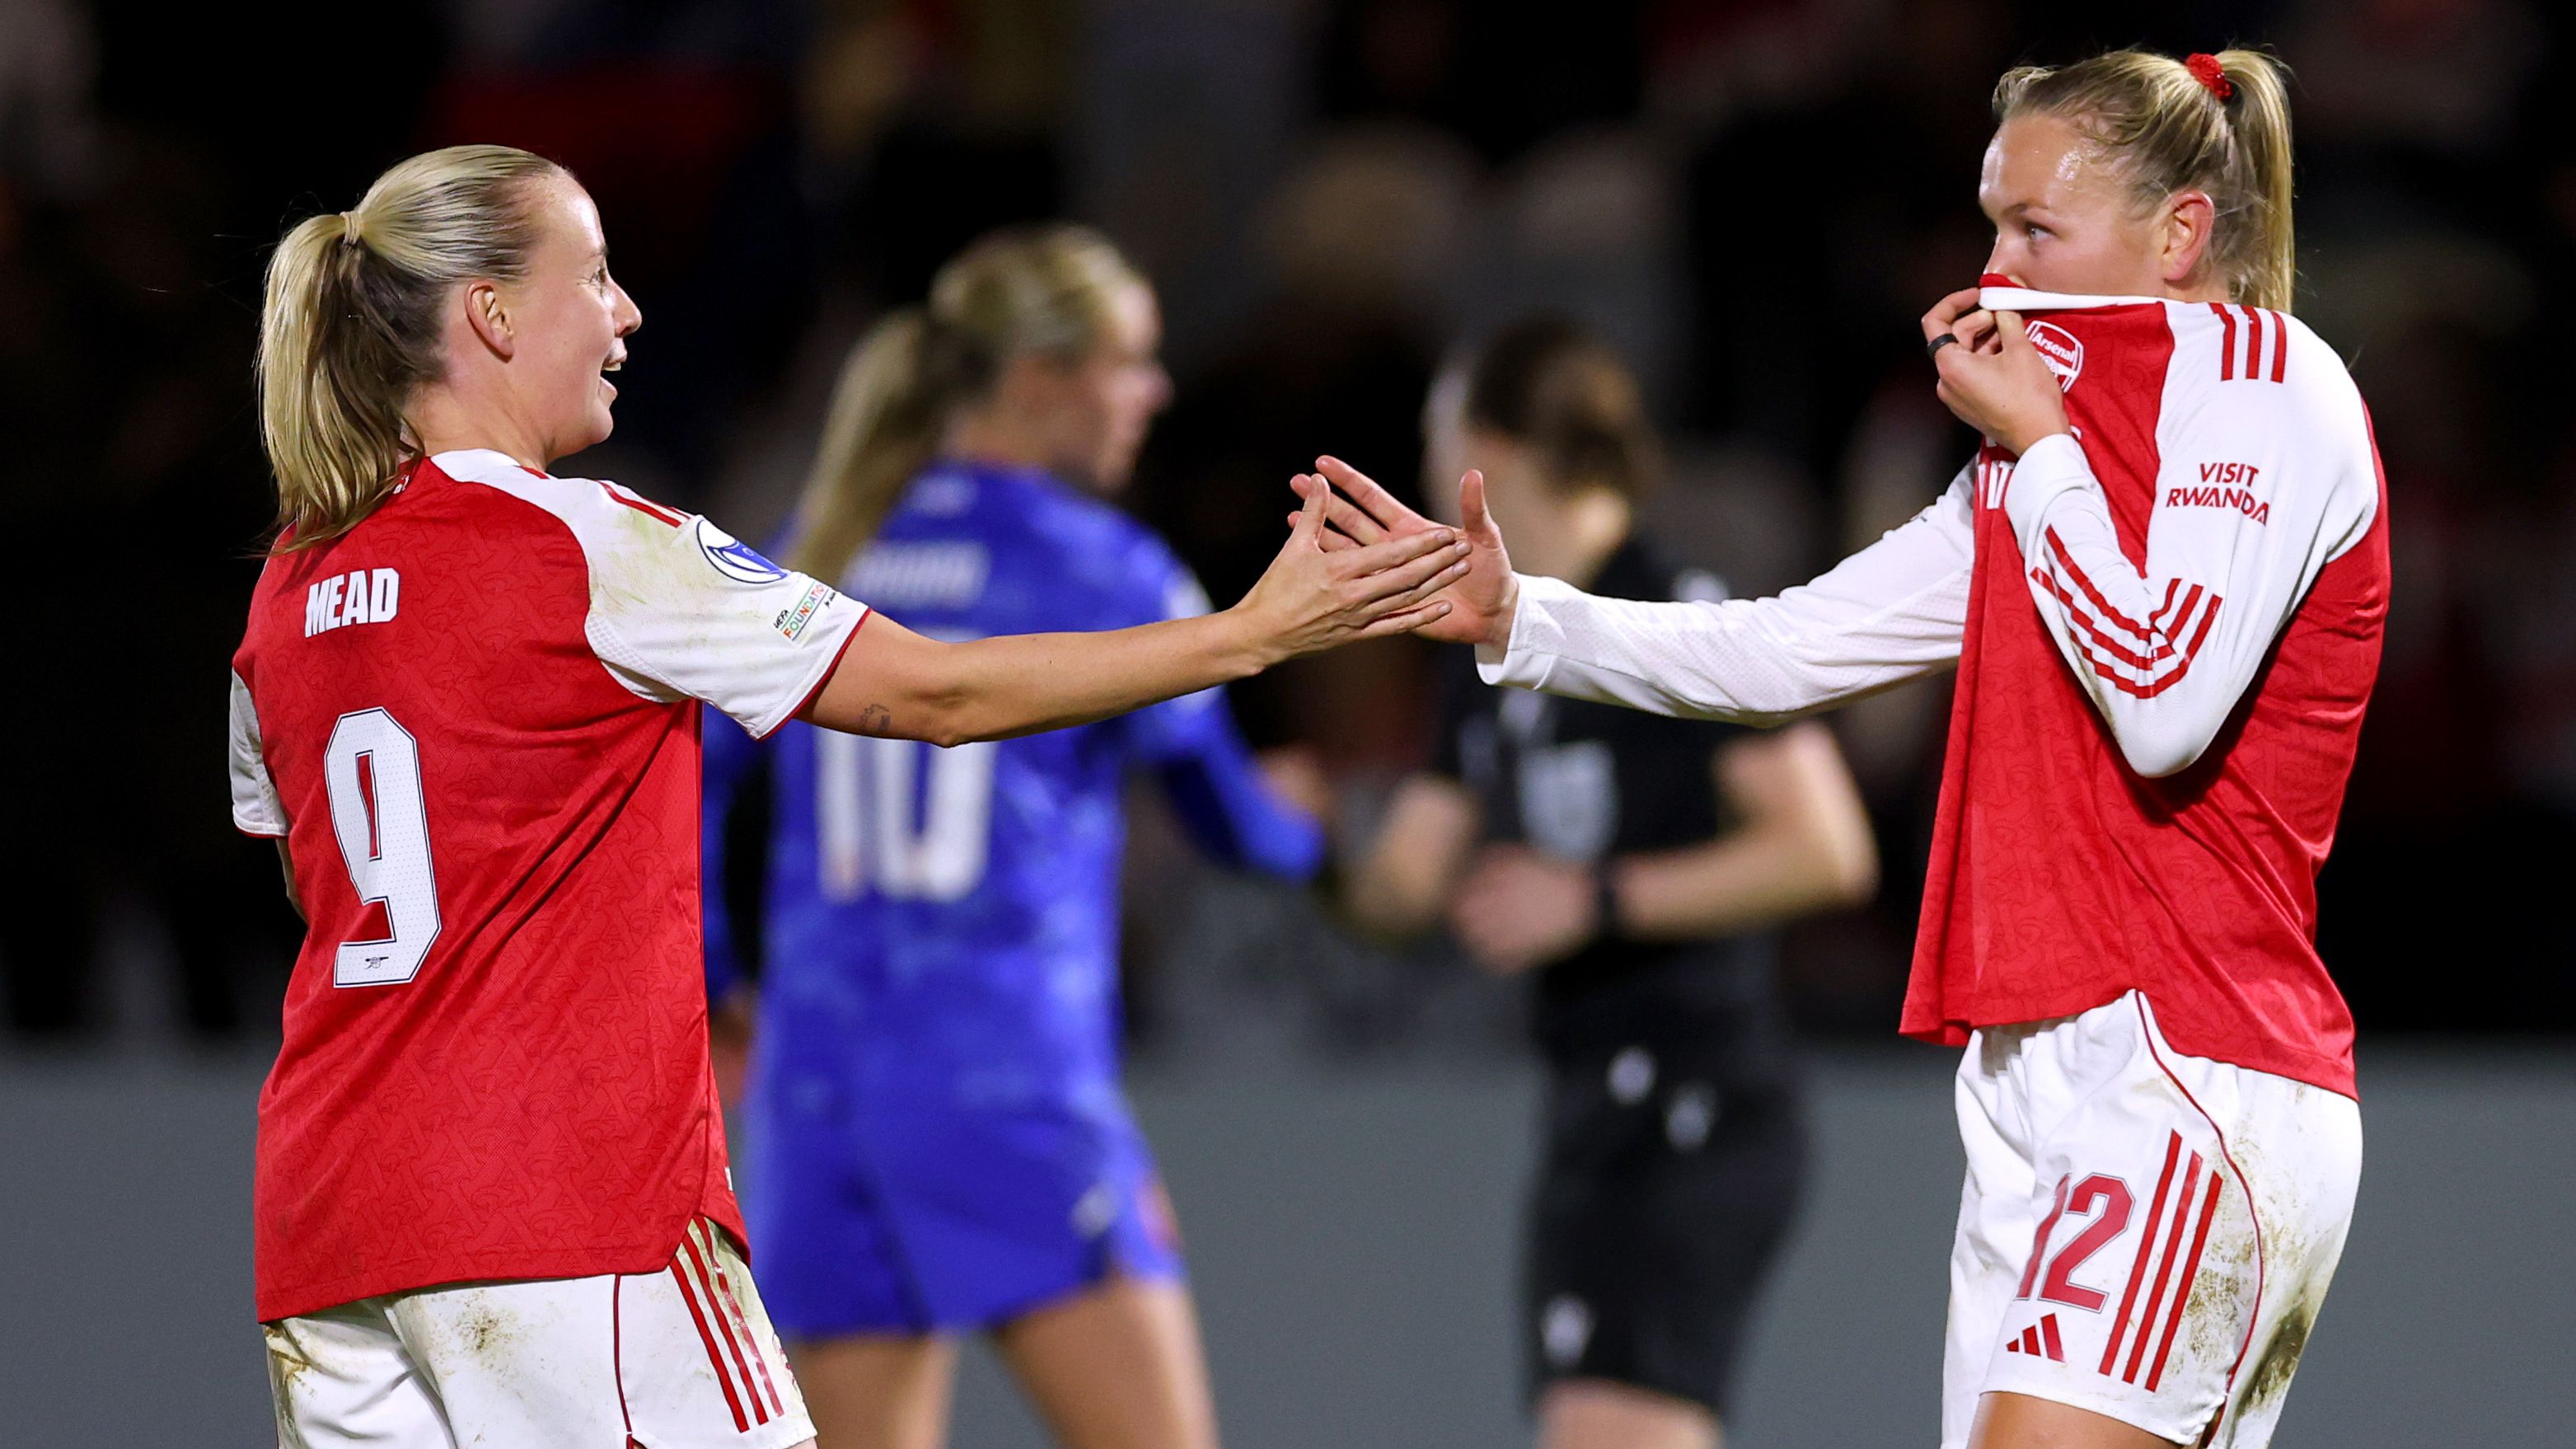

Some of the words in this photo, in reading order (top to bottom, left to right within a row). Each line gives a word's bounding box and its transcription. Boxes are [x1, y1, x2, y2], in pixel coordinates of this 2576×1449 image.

[2031, 331, 2076, 363] Arsenal
[2199, 462, 2260, 488] VISIT
[2166, 486, 2269, 528] RWANDA
[304, 566, 400, 638] MEAD
[773, 609, 789, 629] UEFA
[783, 584, 825, 639] FOUNDATIO
[324, 706, 443, 988] 9
[2013, 1171, 2136, 1315] 12
